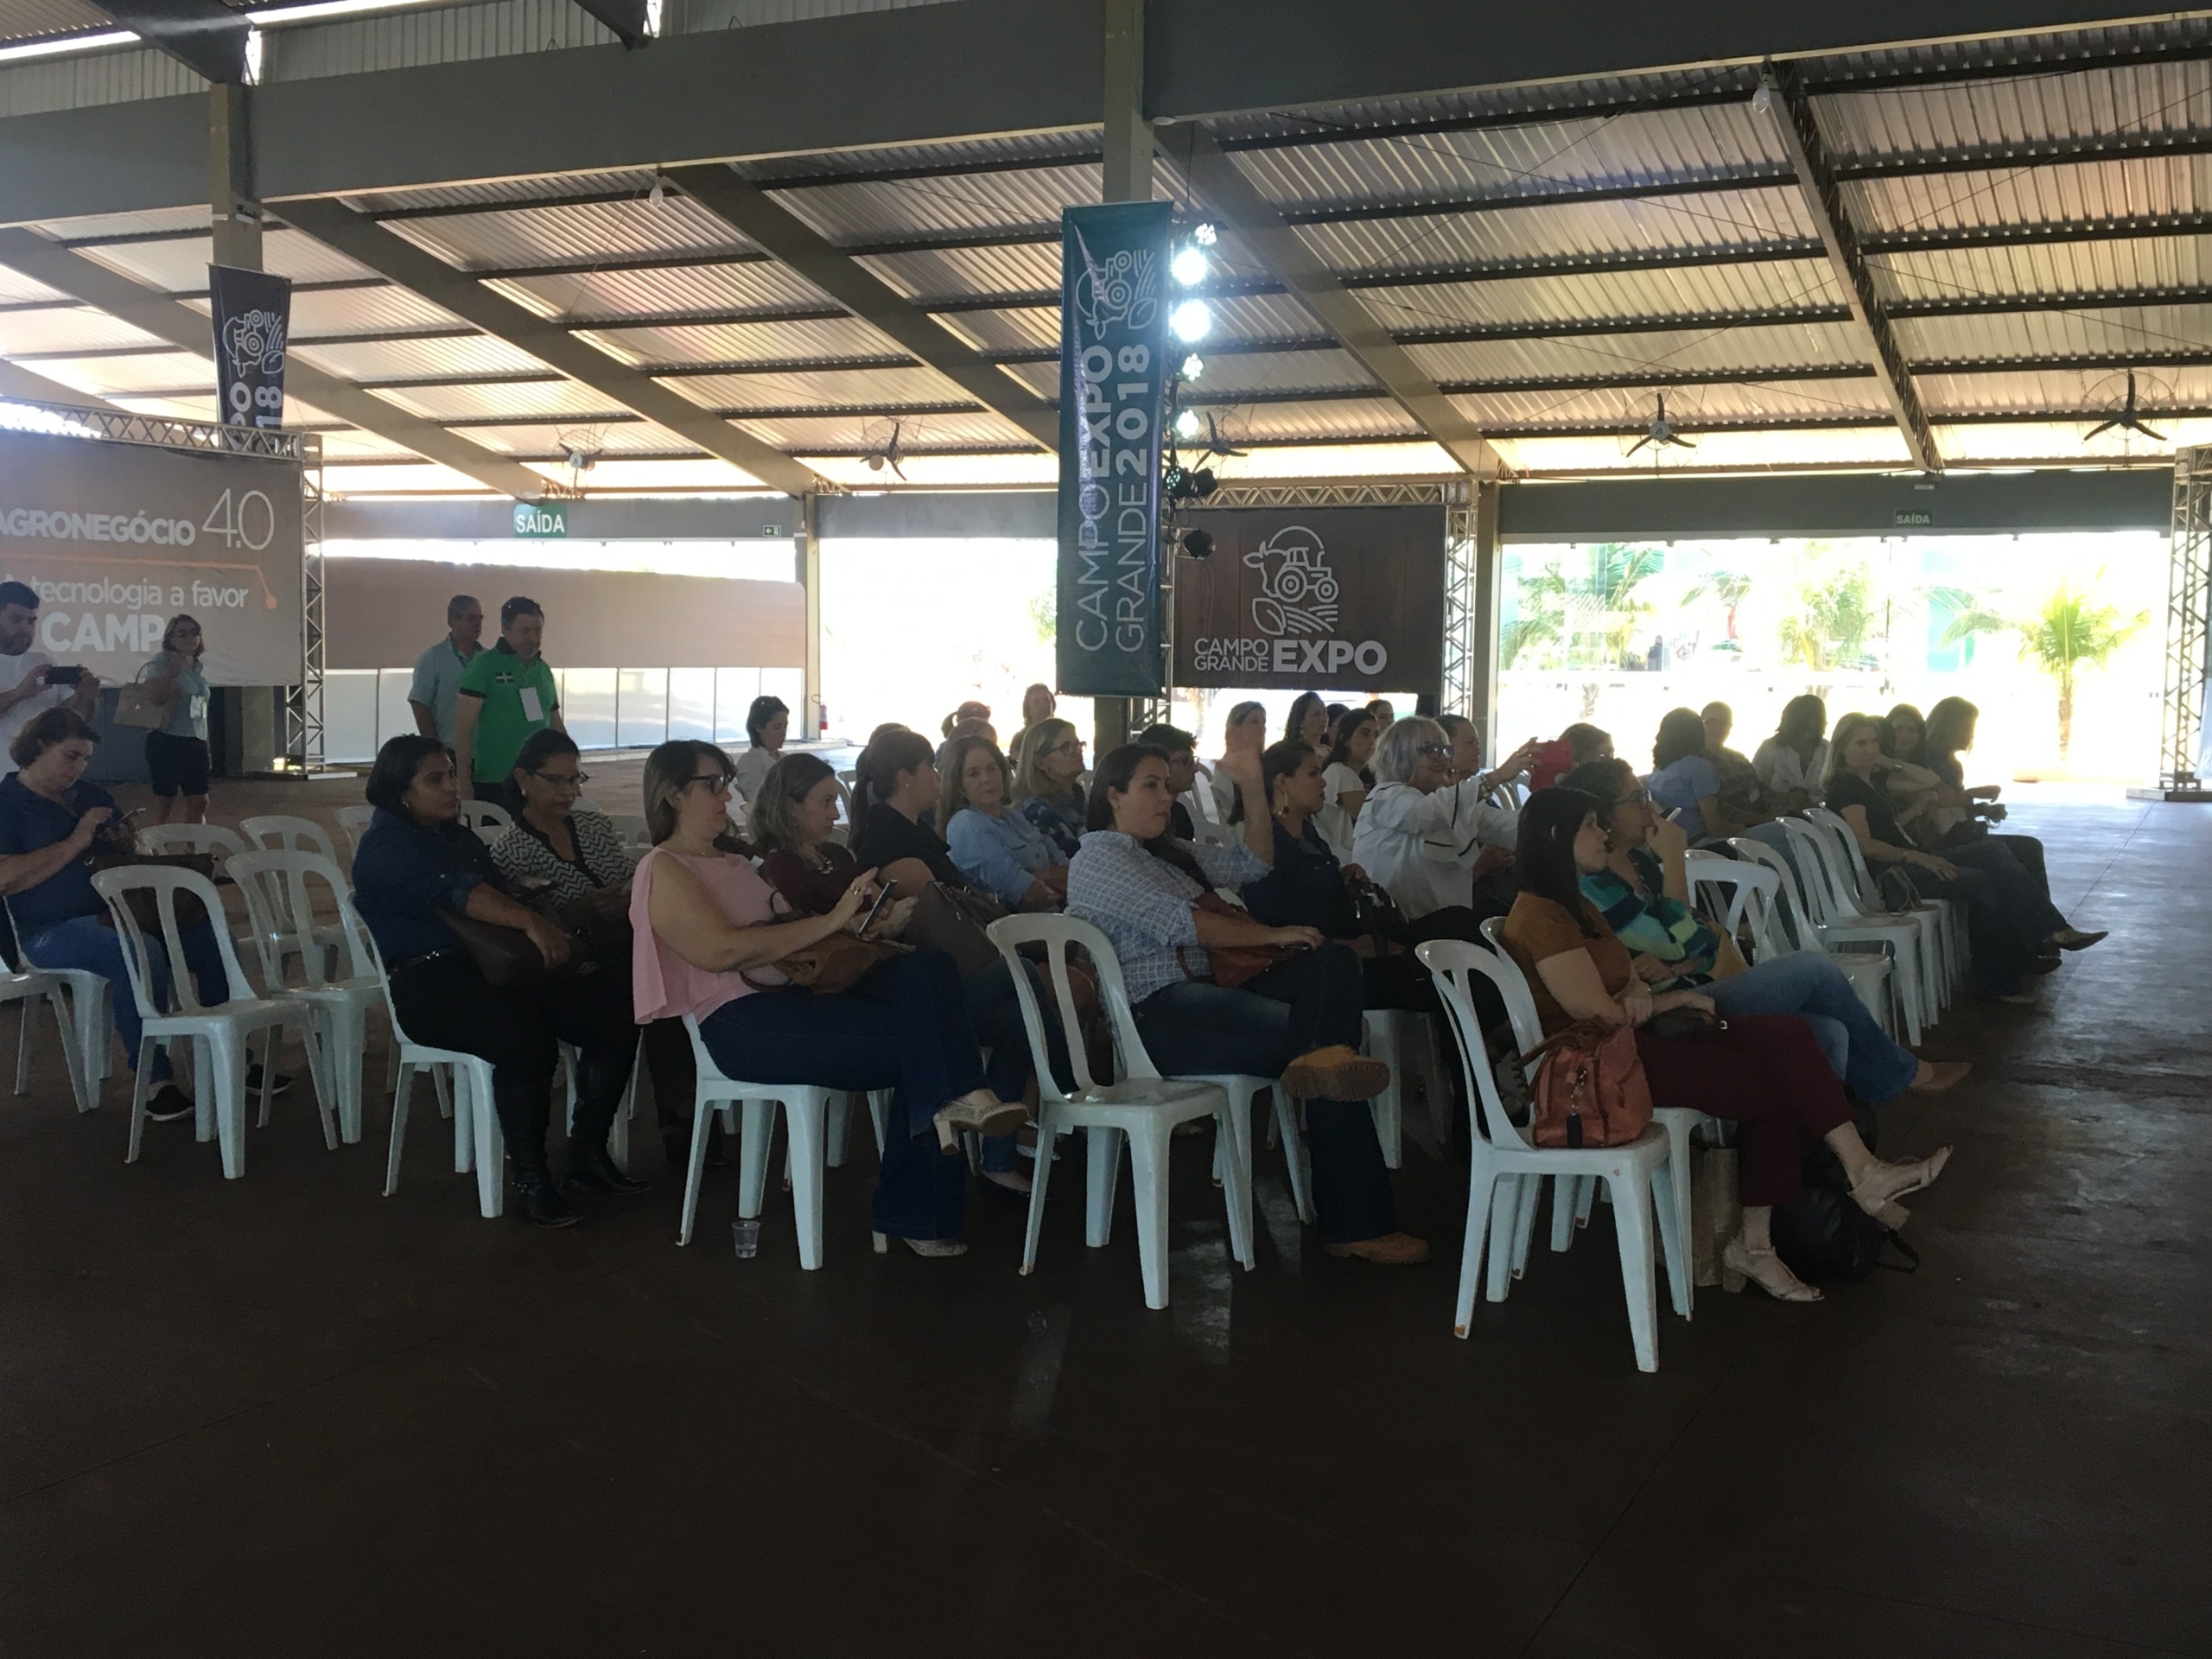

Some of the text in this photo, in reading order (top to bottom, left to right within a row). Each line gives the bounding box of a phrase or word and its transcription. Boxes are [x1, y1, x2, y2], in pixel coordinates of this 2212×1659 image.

[1076, 345, 1113, 652] CAMPO EXPO
[1115, 344, 1150, 652] GRANDE 2018
[201, 487, 275, 551] 4.0
[516, 509, 566, 533] SAÍDA
[1896, 512, 1930, 524] SAÍDA
[29, 575, 249, 610] tecnologia a favor
[41, 611, 167, 653] CAMP
[1194, 638, 1269, 657] CAMPO
[1194, 639, 1388, 676] GRANDE EXPO
